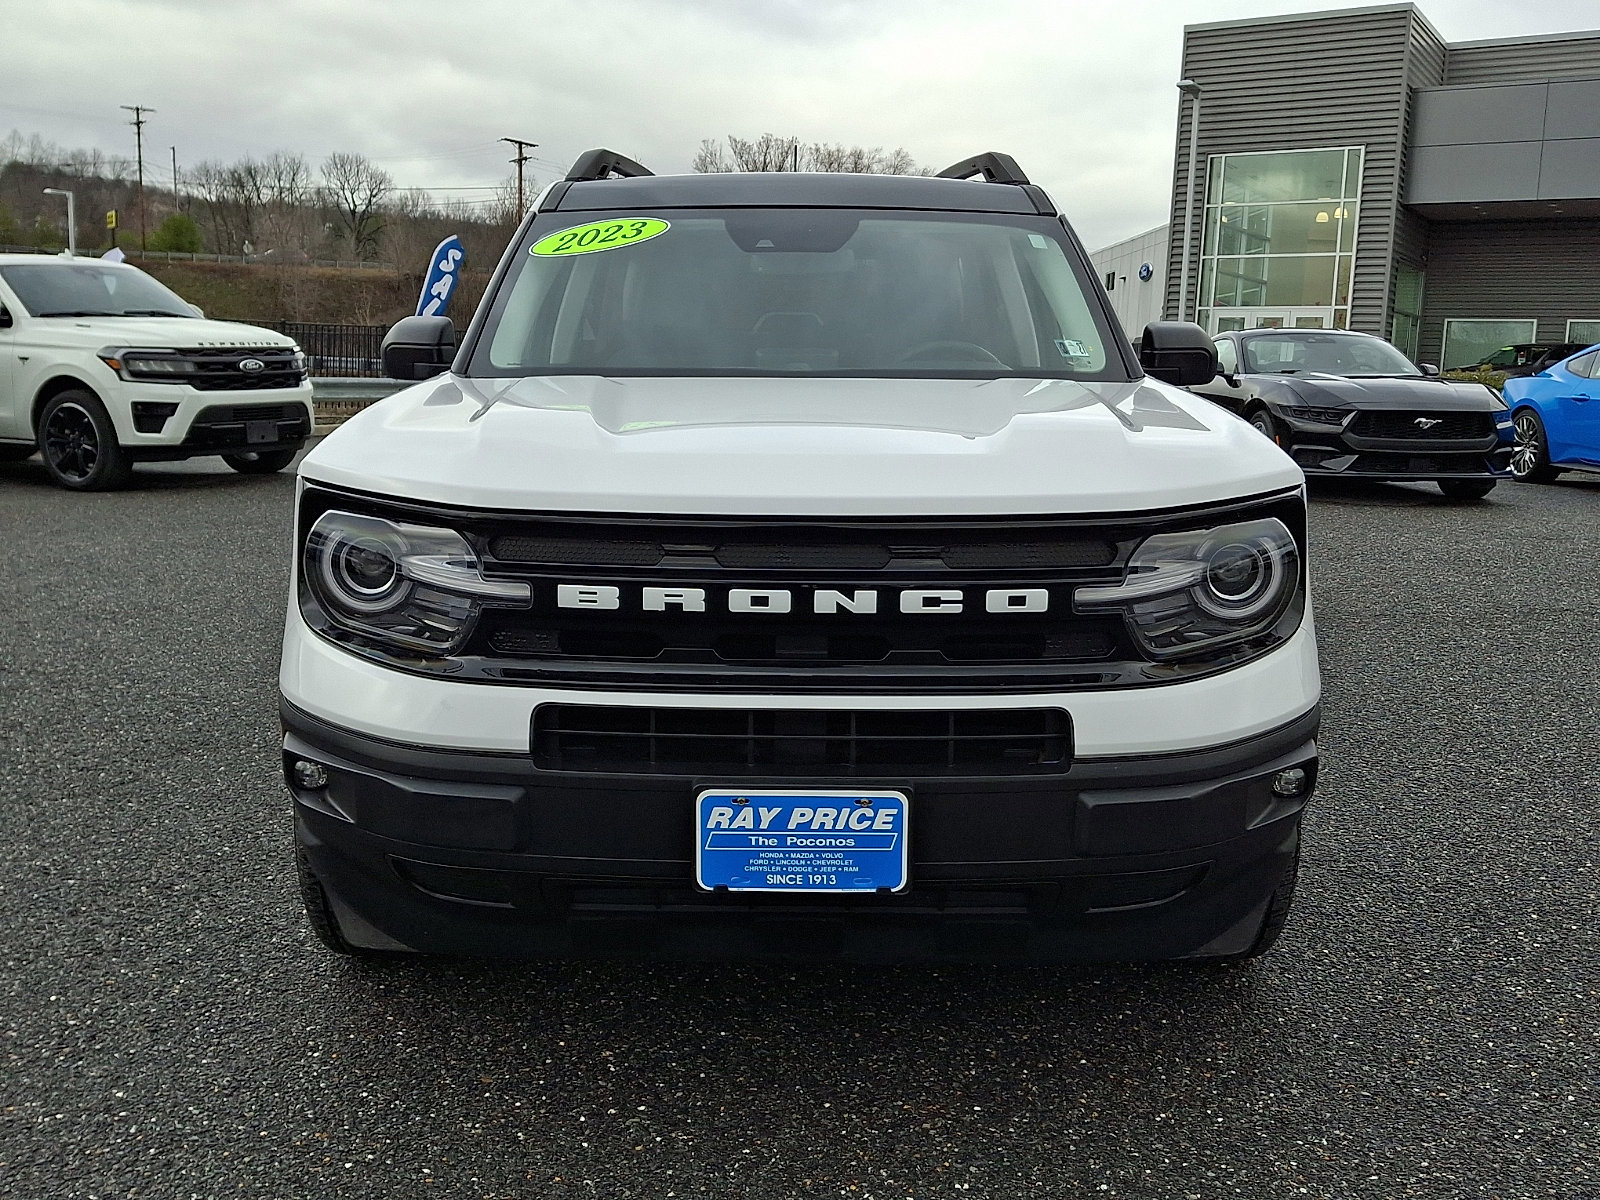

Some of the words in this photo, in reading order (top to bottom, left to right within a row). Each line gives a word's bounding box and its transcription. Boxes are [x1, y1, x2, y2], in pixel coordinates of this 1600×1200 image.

[551, 221, 648, 253] 2023
[557, 585, 1049, 614] BRONCO
[706, 806, 783, 830] RAY
[787, 807, 899, 831] PRICE
[748, 836, 778, 846] The
[786, 836, 855, 847] Poconos
[766, 874, 803, 885] SINCE
[808, 874, 837, 885] 1913
